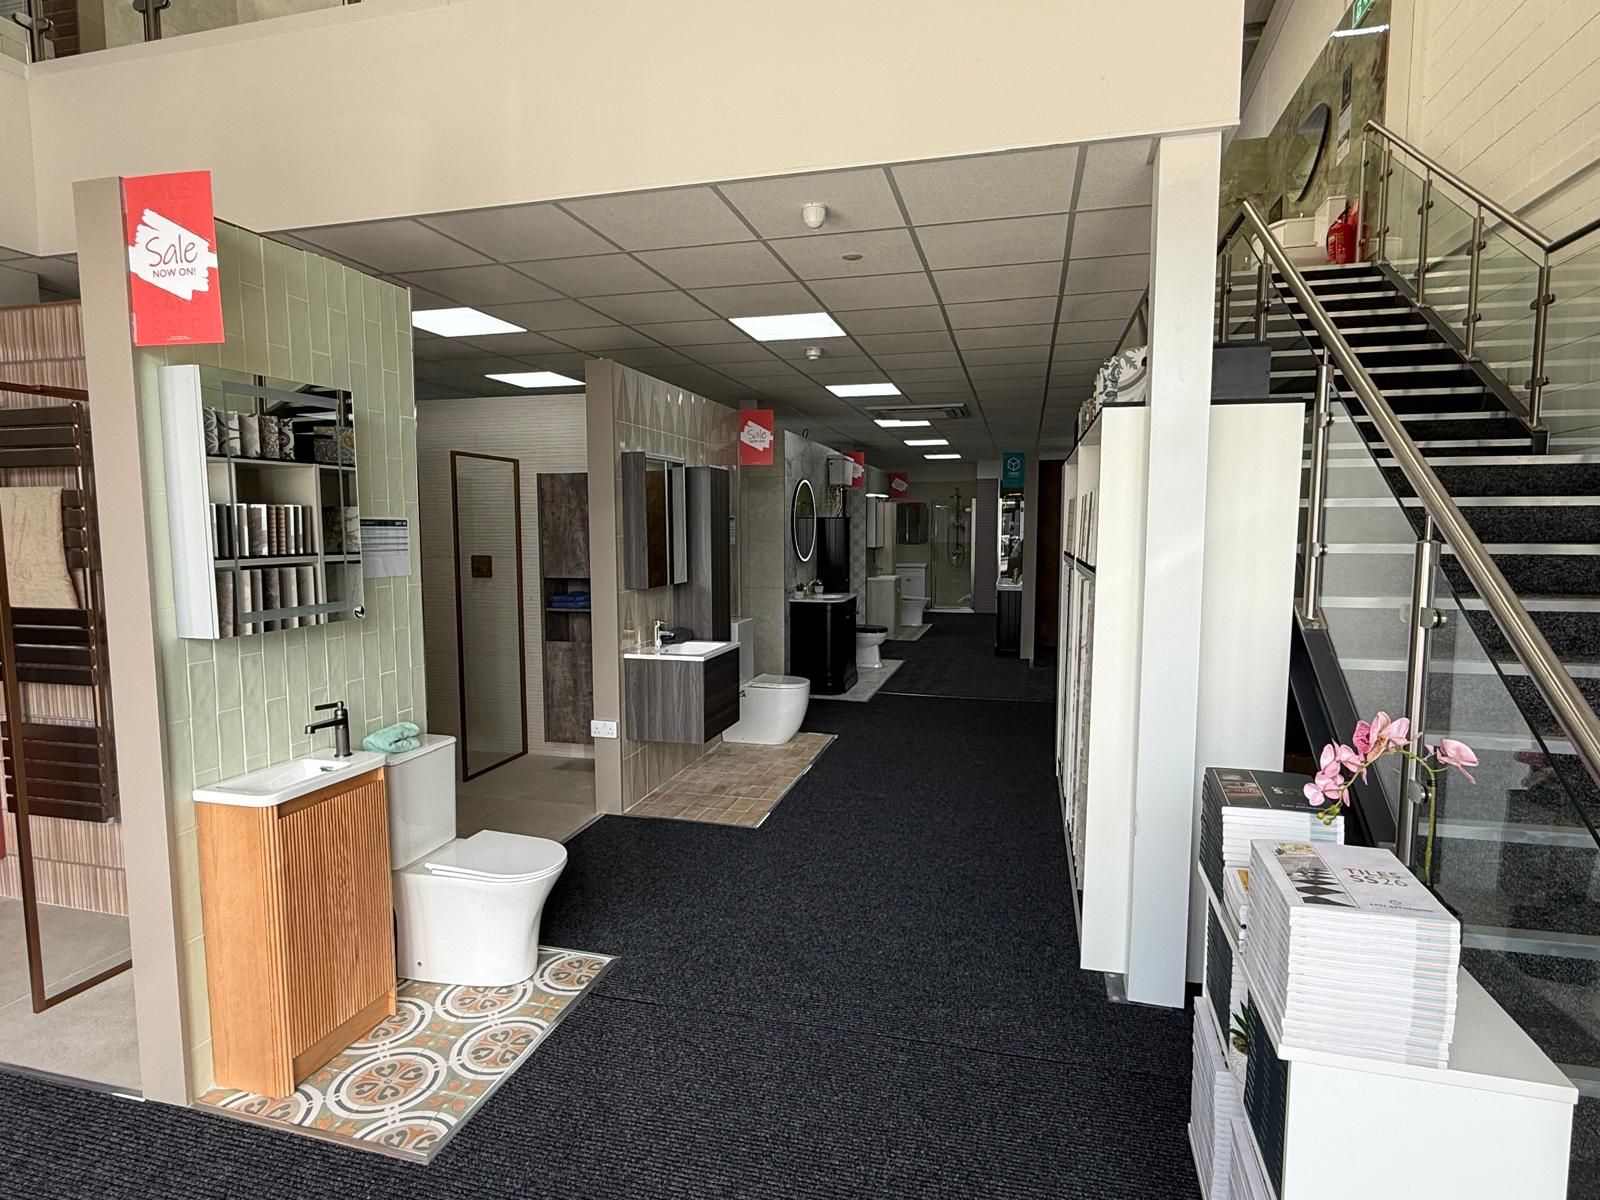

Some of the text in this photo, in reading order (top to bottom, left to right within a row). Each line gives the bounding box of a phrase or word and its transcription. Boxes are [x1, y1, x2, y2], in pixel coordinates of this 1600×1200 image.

[145, 233, 198, 268] Sale
[152, 266, 196, 278] NOW ON!
[746, 428, 767, 440] Sale
[1343, 867, 1401, 879] TILES
[1349, 874, 1408, 887] SS26
